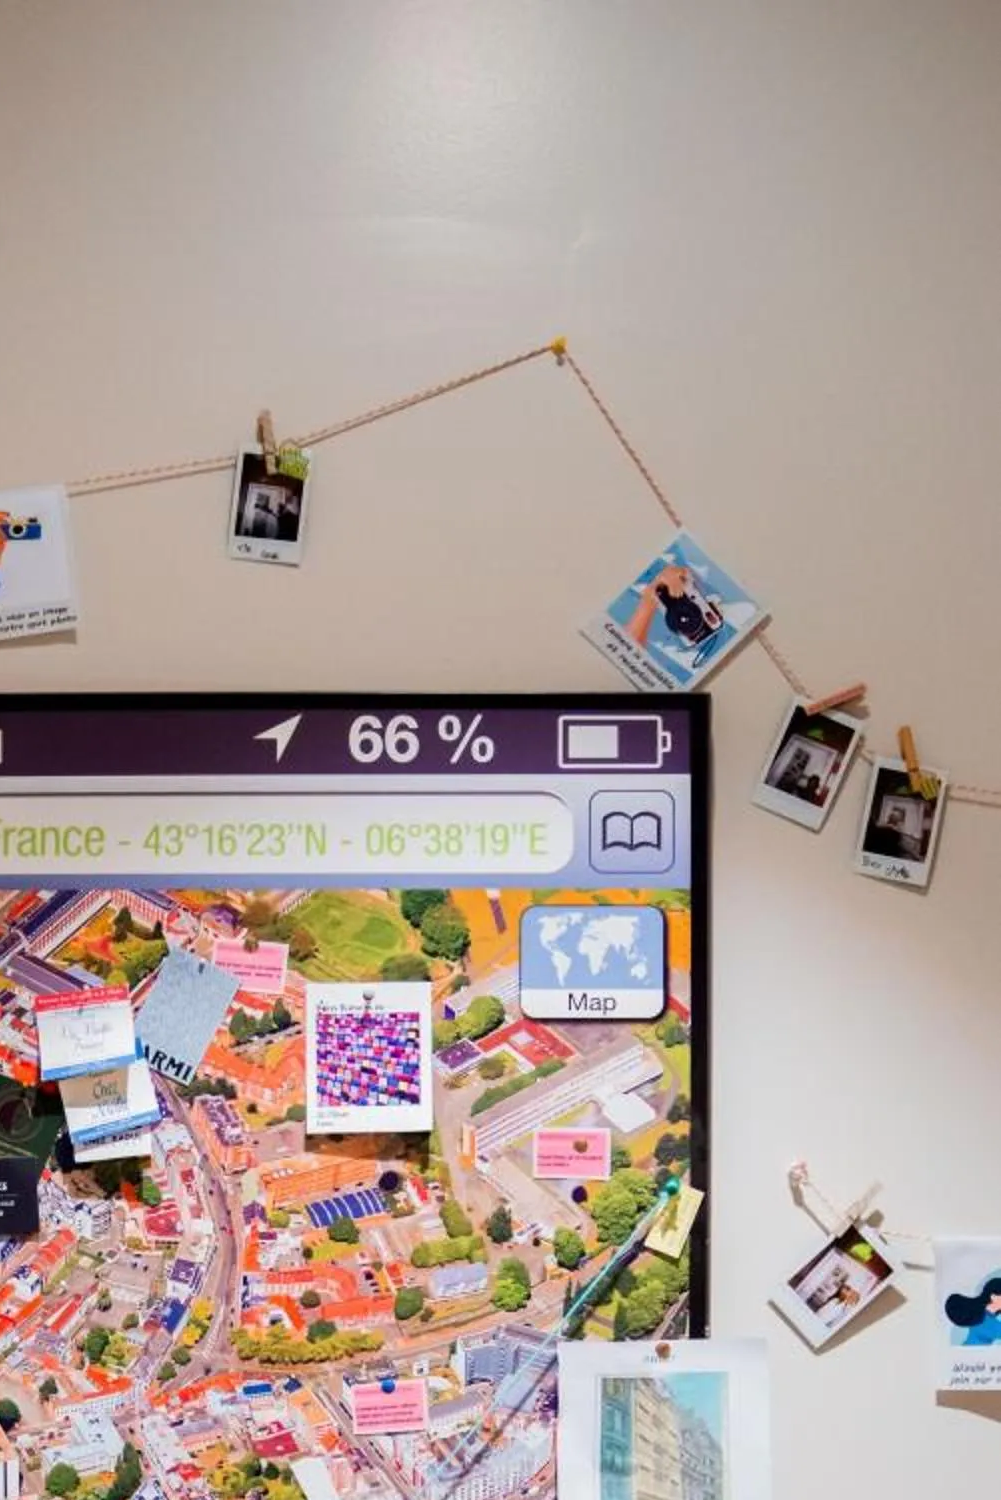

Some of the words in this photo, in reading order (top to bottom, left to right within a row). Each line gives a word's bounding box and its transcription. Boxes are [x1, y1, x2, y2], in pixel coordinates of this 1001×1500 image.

[347, 714, 421, 764] 66
[437, 713, 496, 765] %
[567, 993, 617, 1015] Map
